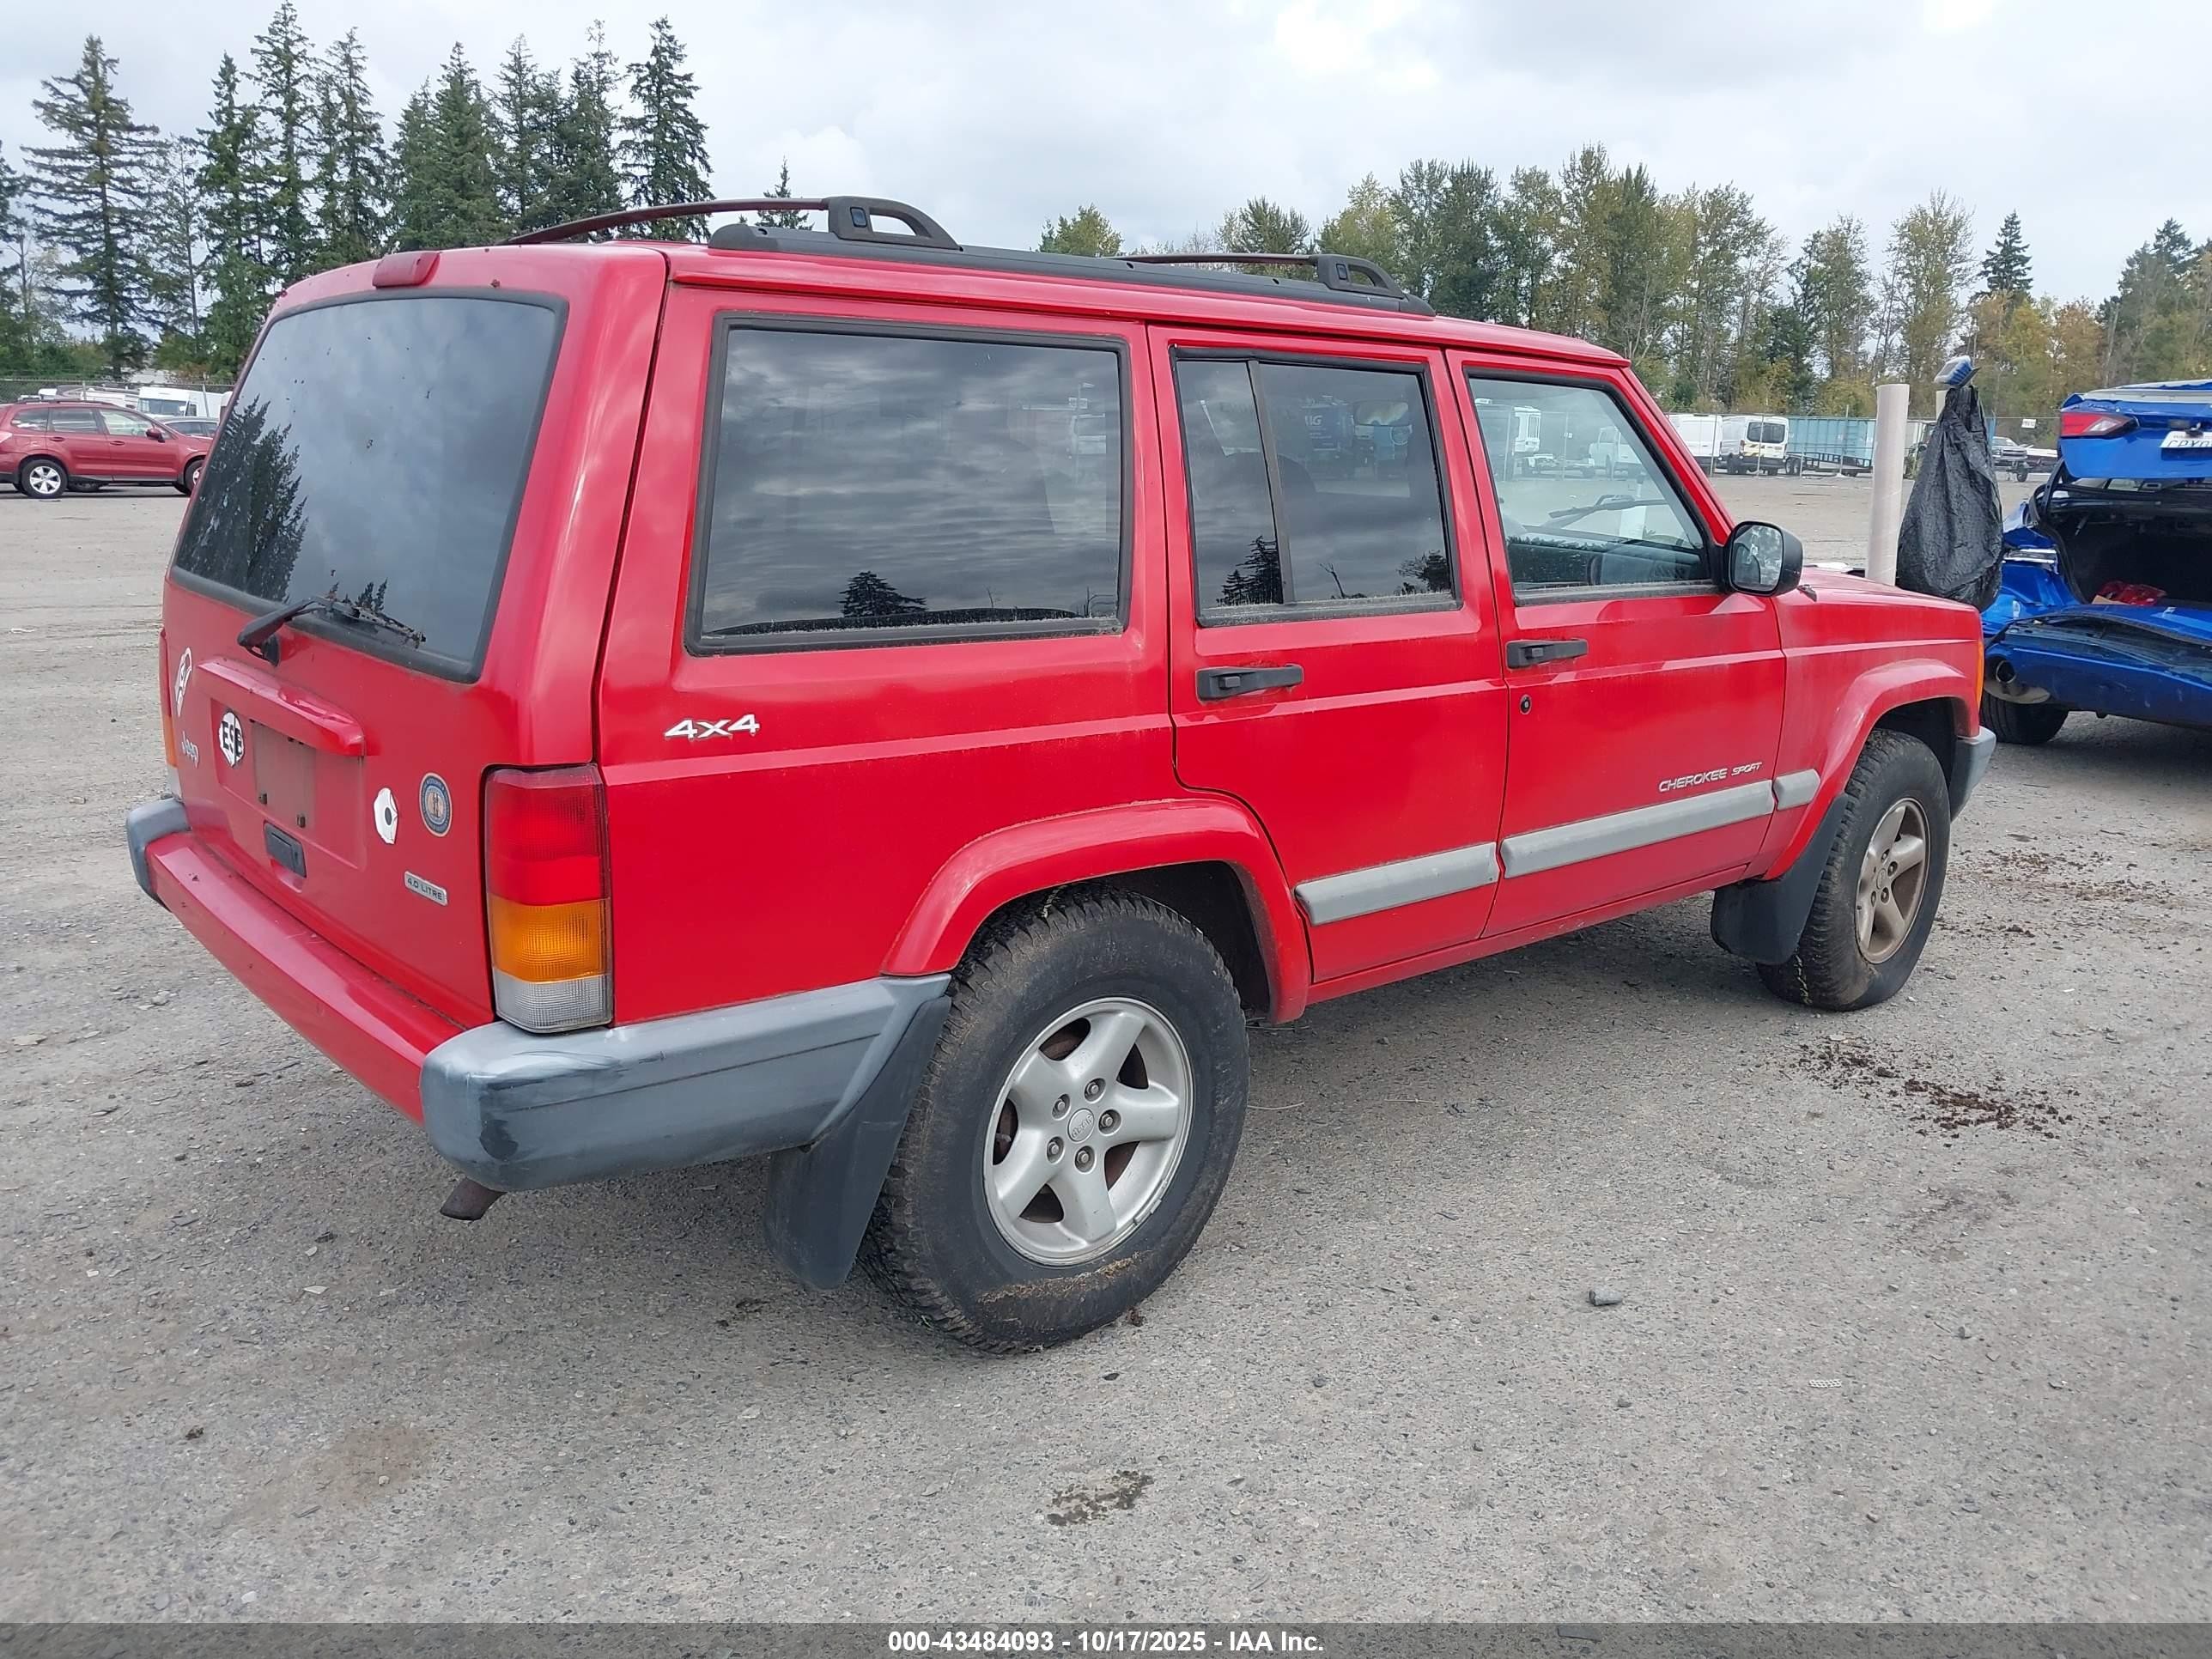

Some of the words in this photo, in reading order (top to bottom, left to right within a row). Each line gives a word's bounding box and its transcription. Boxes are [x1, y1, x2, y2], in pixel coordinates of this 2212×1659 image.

[1658, 768, 1728, 792] CHEROKEE
[1730, 762, 1762, 776] SPORT
[421, 884, 443, 901] LITRE
